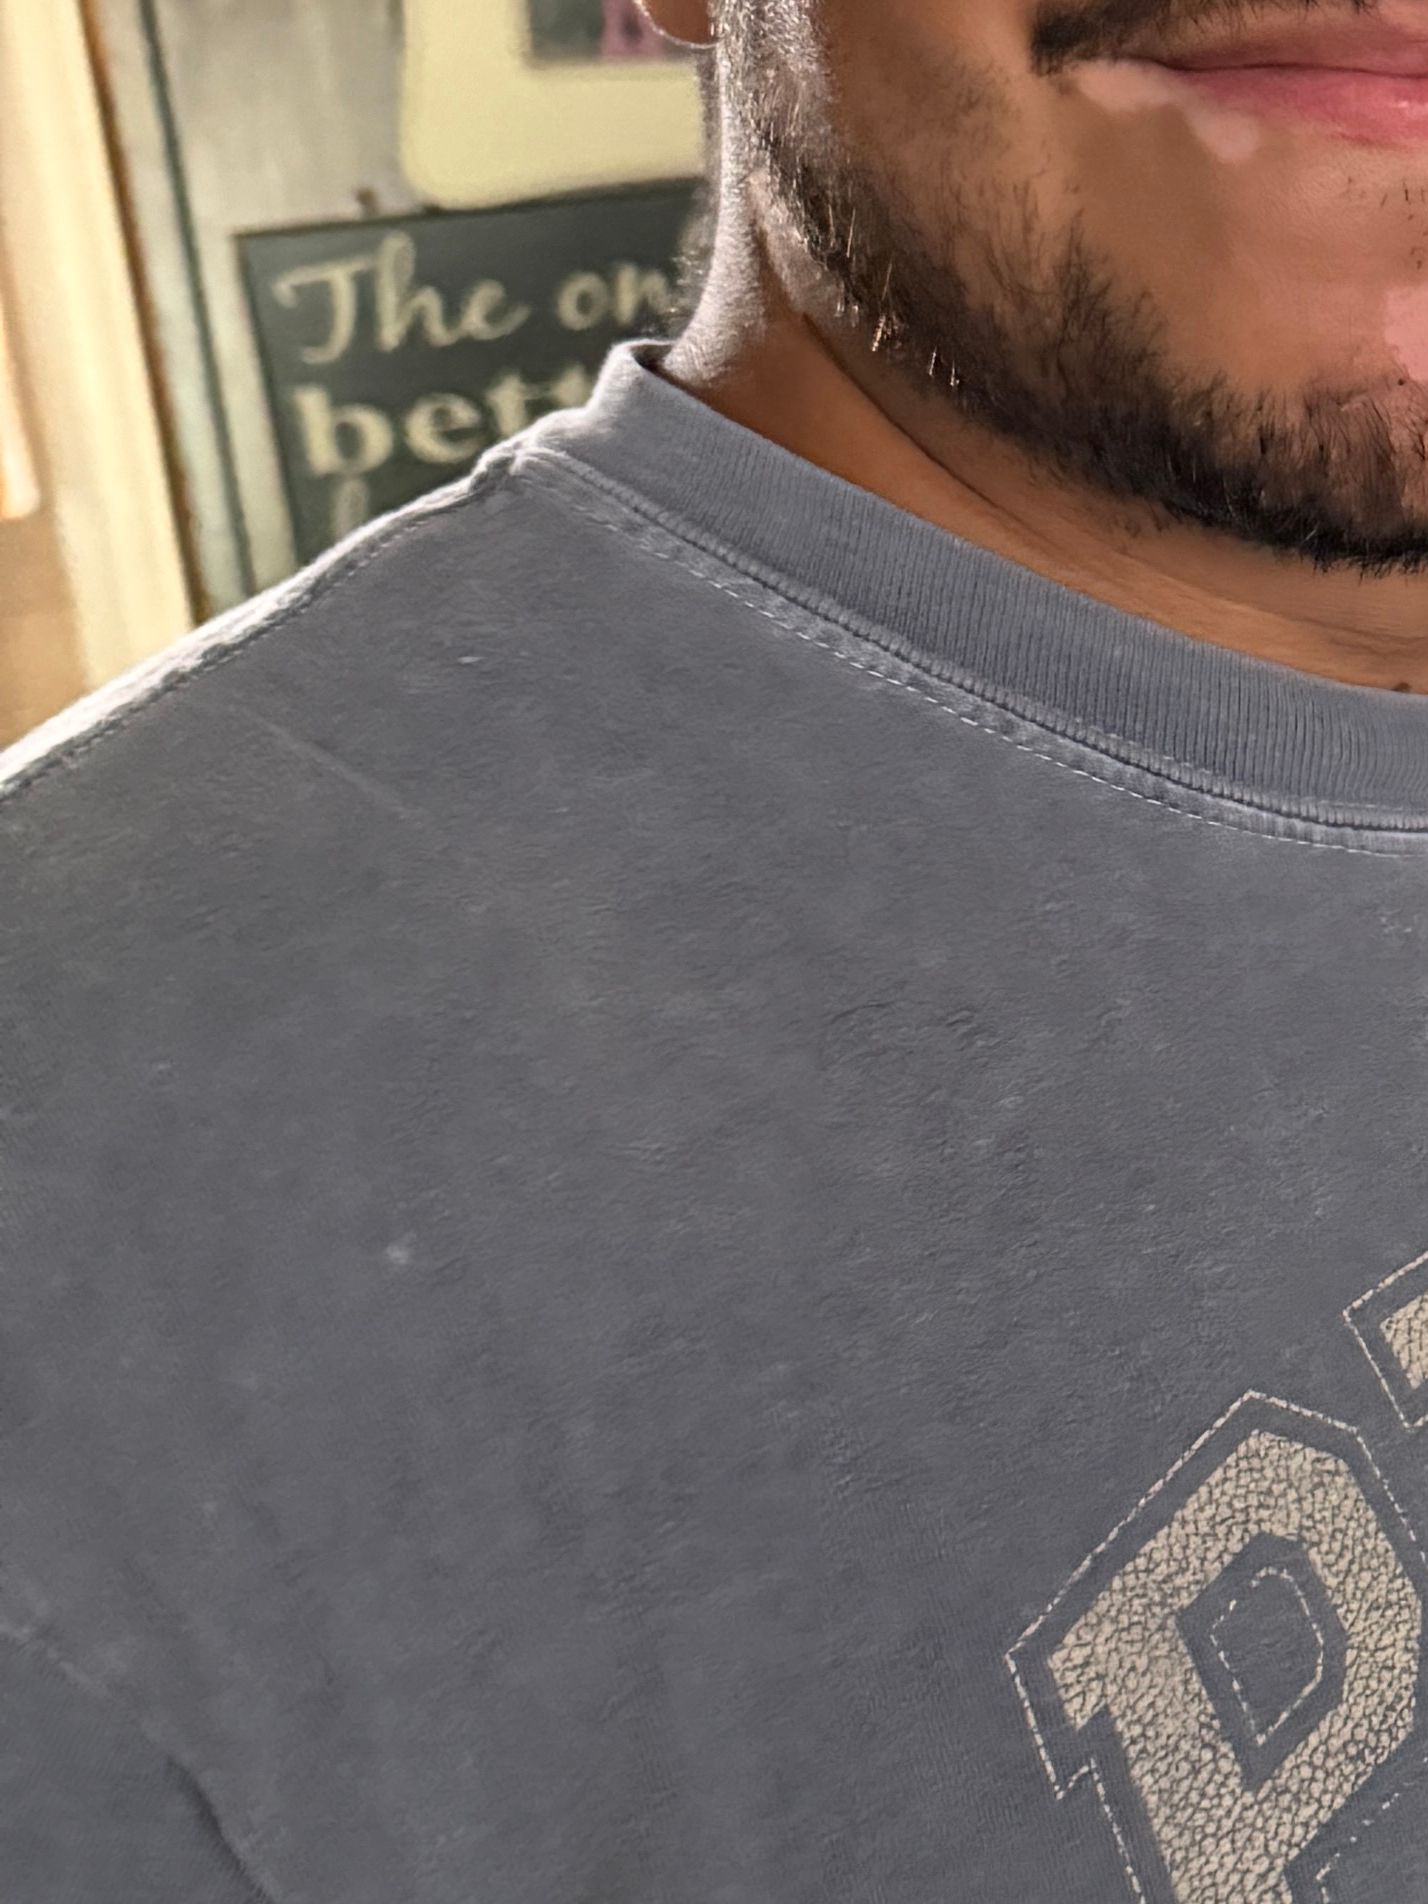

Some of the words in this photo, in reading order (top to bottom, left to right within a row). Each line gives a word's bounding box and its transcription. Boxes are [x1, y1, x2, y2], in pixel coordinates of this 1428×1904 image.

[270, 230, 532, 366] The
[556, 260, 672, 332] on
[296, 362, 596, 478] bett
